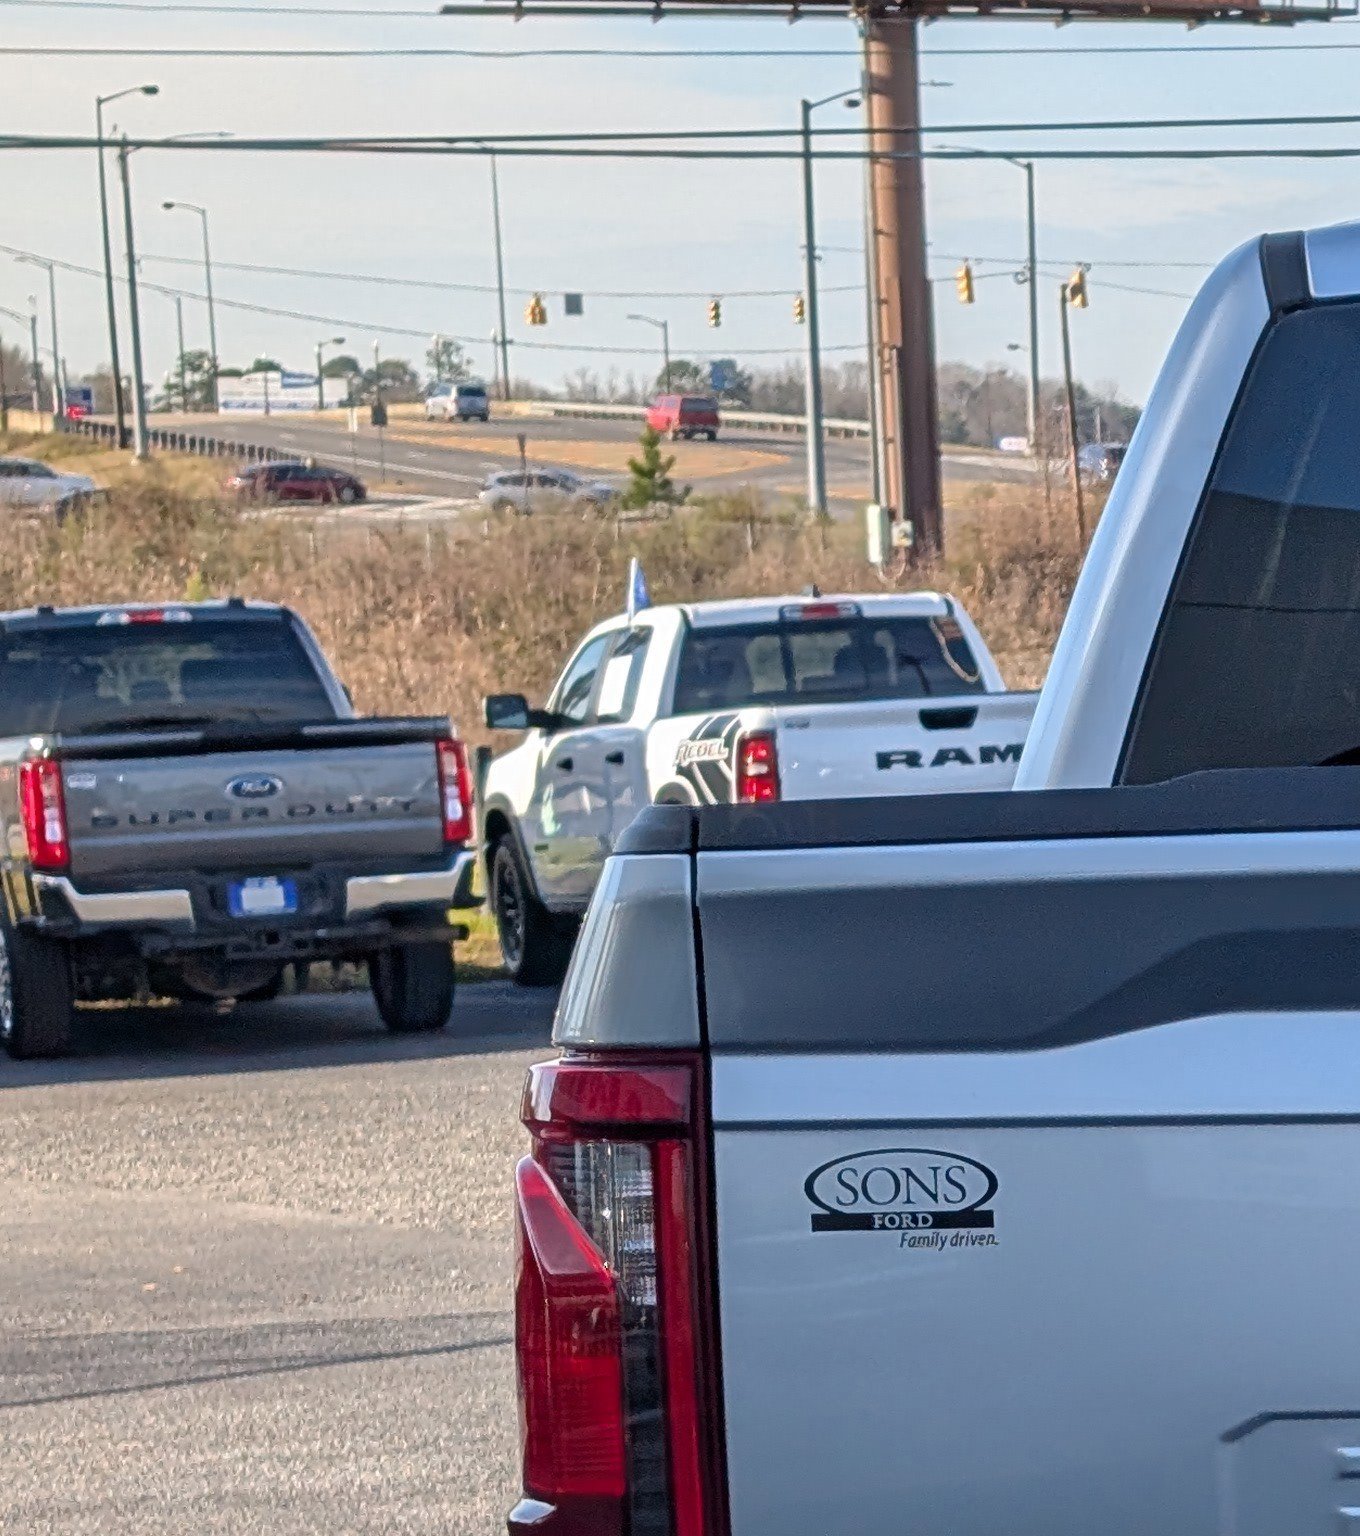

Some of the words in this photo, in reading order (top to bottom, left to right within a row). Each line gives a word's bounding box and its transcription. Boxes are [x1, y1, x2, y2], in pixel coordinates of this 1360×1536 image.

[875, 743, 1026, 771] RAM
[91, 806, 269, 829] SUPER
[835, 1165, 967, 1207] SONS
[873, 1213, 934, 1229] FORD
[899, 1231, 948, 1252] Family
